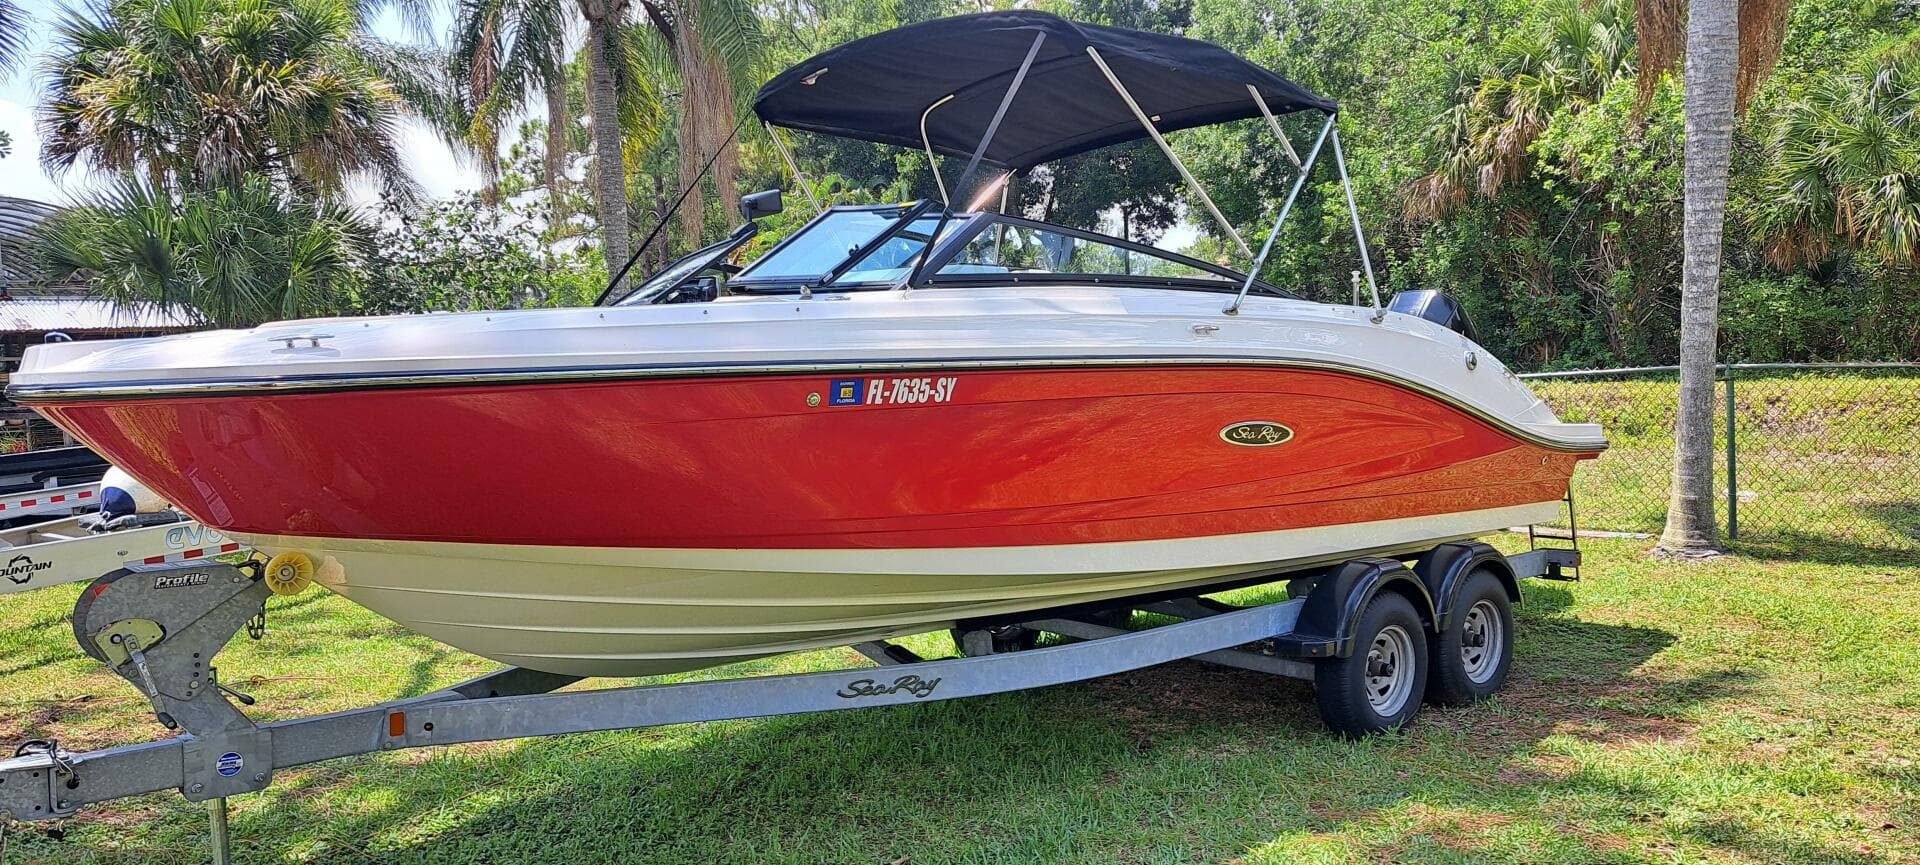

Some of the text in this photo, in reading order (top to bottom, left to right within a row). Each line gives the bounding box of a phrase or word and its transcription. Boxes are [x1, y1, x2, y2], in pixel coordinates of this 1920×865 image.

[866, 377, 958, 405] FL-7635-SY
[1233, 426, 1282, 442] Sea Ray
[155, 573, 209, 586] Profile
[836, 675, 942, 698] Sea Ray
